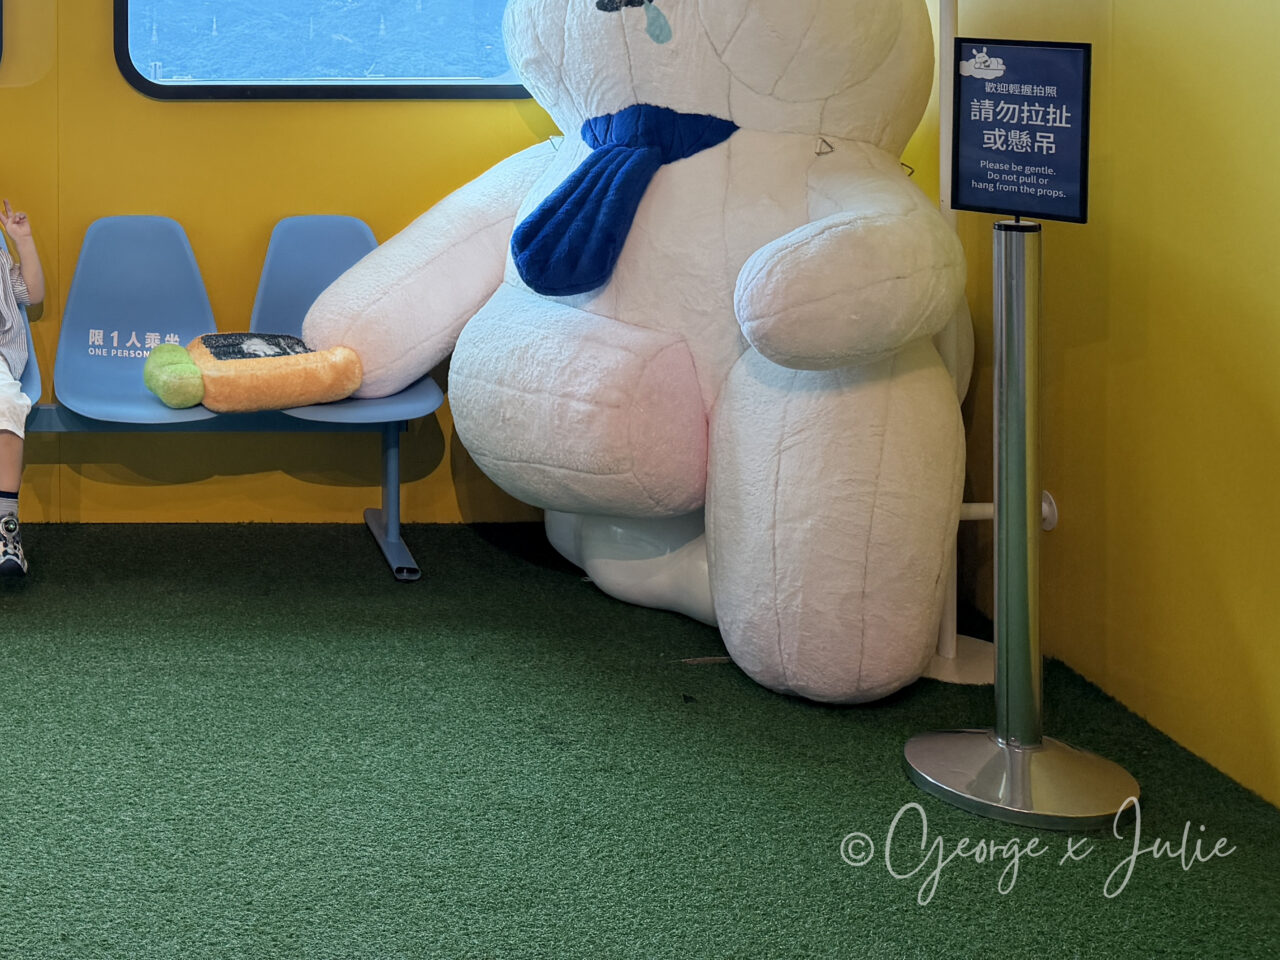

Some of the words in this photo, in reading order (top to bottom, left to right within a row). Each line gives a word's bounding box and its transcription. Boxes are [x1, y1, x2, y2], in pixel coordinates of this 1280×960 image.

[985, 82, 1057, 98] 歡迎輕握拍照
[970, 98, 1072, 128] 請勿拉扯
[982, 127, 1056, 155] 或懸吊
[980, 160, 1010, 171] Please
[1011, 162, 1023, 172] be
[1024, 164, 1057, 175] gentle.
[987, 171, 1000, 180] Do
[1001, 173, 1017, 182] not
[1019, 174, 1037, 185] pull
[1038, 177, 1049, 185] or
[971, 180, 994, 191] hang
[996, 181, 1018, 192] from
[1020, 184, 1036, 194] the
[1037, 187, 1067, 199] props.
[88, 347, 108, 356] ONE
[111, 349, 150, 358] PERSON
